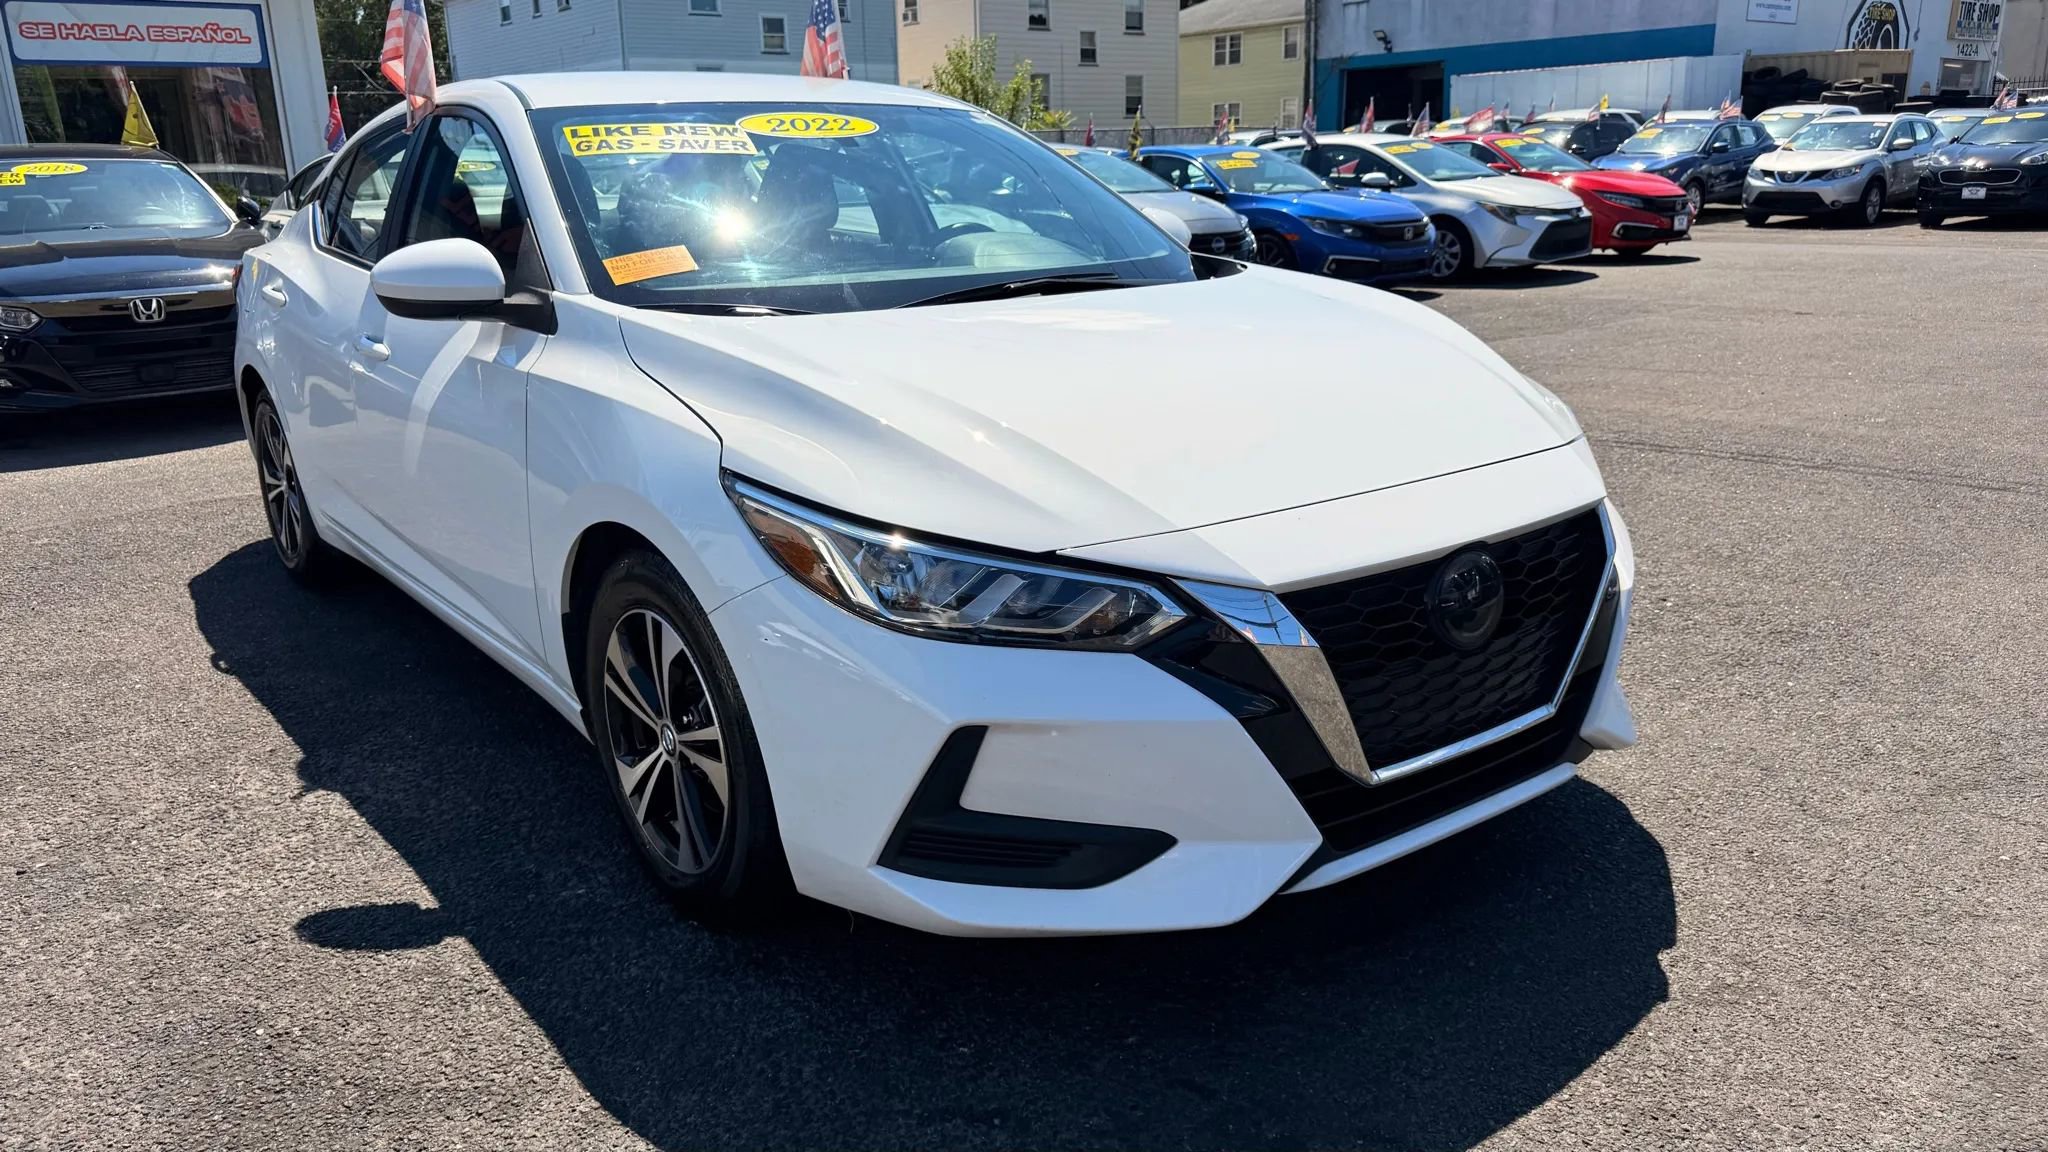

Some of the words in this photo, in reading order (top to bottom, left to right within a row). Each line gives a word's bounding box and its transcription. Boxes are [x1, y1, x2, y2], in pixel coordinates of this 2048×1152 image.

[1960, 1, 1977, 21] TIRE
[1977, 3, 2000, 23] SHOP
[19, 22, 54, 40] SE
[58, 23, 144, 41] HABLA
[147, 22, 251, 44] ESPAÑOL
[1956, 43, 1979, 57] 1422-A
[570, 125, 652, 139] LIKE
[664, 125, 740, 138] NEW
[766, 118, 855, 133] 2022
[575, 139, 634, 153] GAS
[657, 139, 750, 153] SAVER
[26, 165, 75, 173] 2018
[609, 256, 633, 265] THIS
